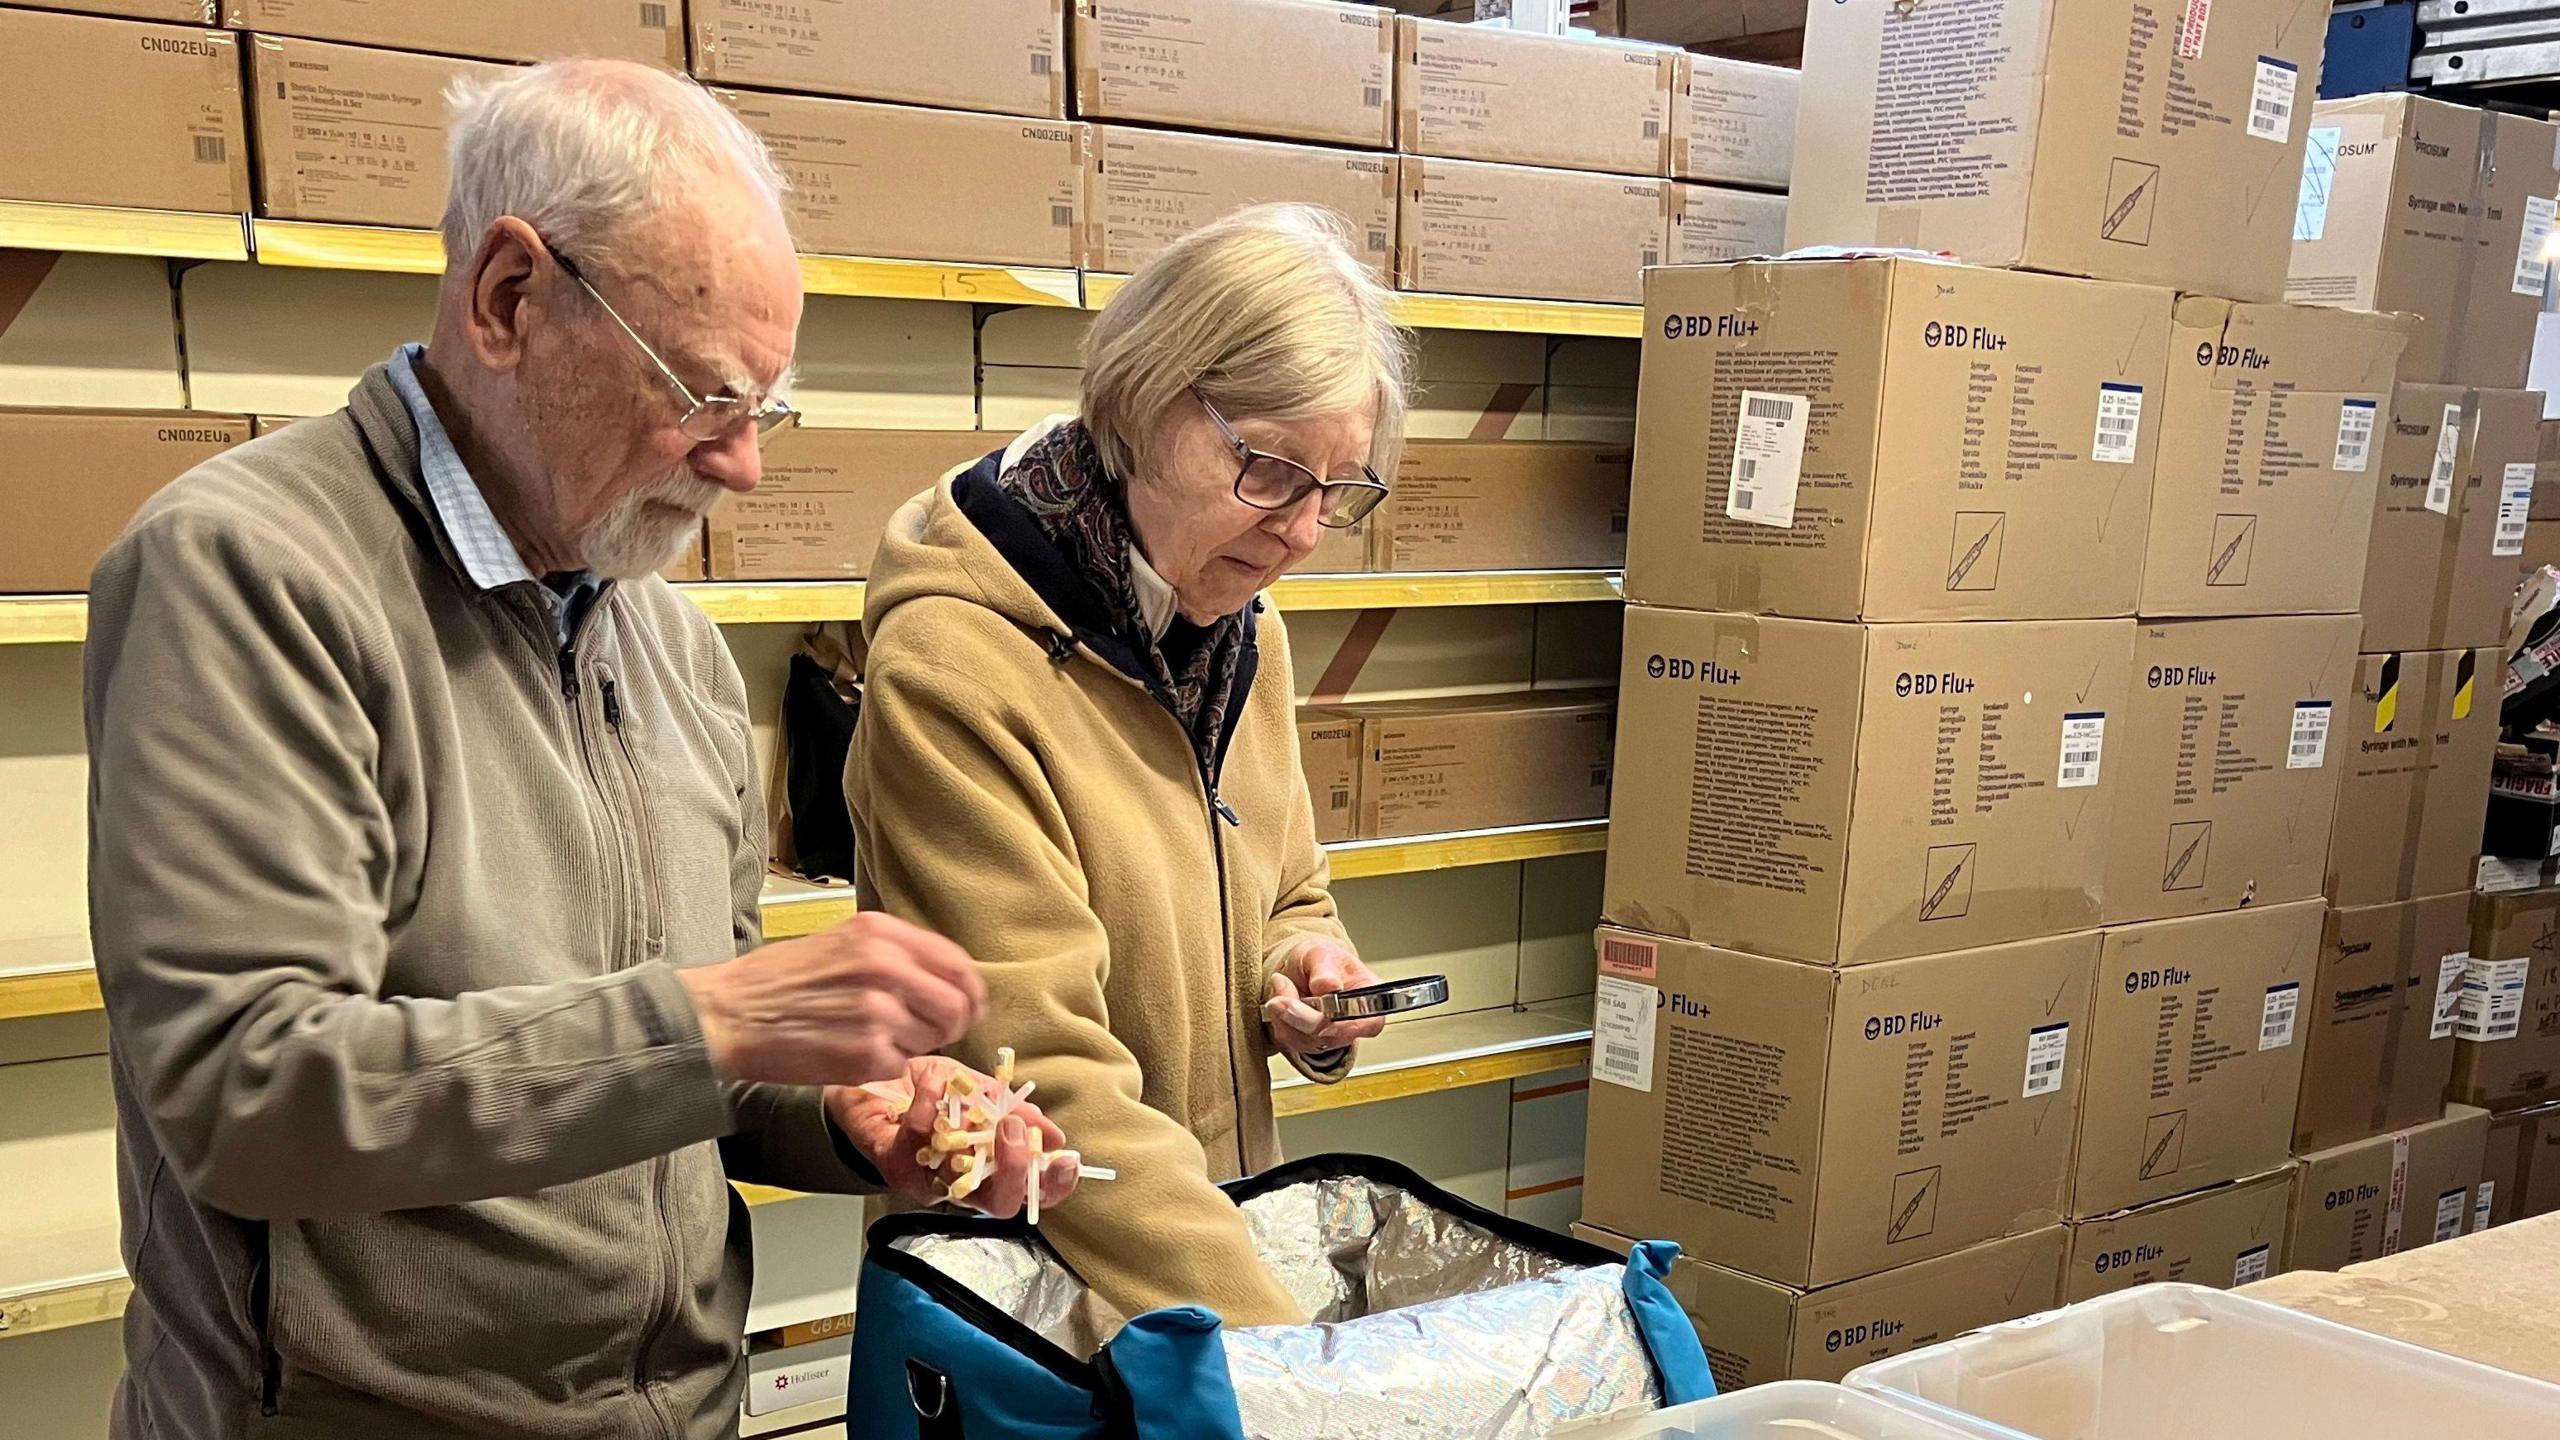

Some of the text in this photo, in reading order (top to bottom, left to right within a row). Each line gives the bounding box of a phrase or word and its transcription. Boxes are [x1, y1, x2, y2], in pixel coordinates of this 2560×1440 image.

[2197, 2, 2207, 21] BOX
[141, 36, 217, 58] CN002EUa
[1022, 127, 1073, 143] CN002EUa
[2338, 144, 2374, 157] OSUM
[2415, 142, 2449, 158] PROSUM
[2408, 195, 2439, 213] Syringe
[2440, 202, 2457, 215] with
[1686, 314, 1760, 337] BD Flu+
[1945, 325, 2007, 350] BD Flu+
[2217, 346, 2271, 369] BD Flu+
[158, 429, 231, 443] CN002EUa
[2396, 423, 2430, 437] PROSUM
[2390, 474, 2419, 488] Syringe
[1669, 658, 1742, 685] BD Flu+
[2164, 666, 2217, 686] BD Flu+
[1915, 672, 1975, 694] BD Flu+
[2361, 740, 2390, 754] Syringe
[2141, 967, 2192, 989] BD Flu+
[1672, 993, 1712, 1019] Flu+
[1884, 1010, 1943, 1036] BD Flu+
[2338, 1184, 2380, 1206] BD Flu+
[2112, 1244, 2165, 1269] BD Flu+
[811, 1319, 832, 1335] GB
[1844, 1319, 1905, 1347] BD Flu+
[790, 1369, 830, 1385] Hollister
